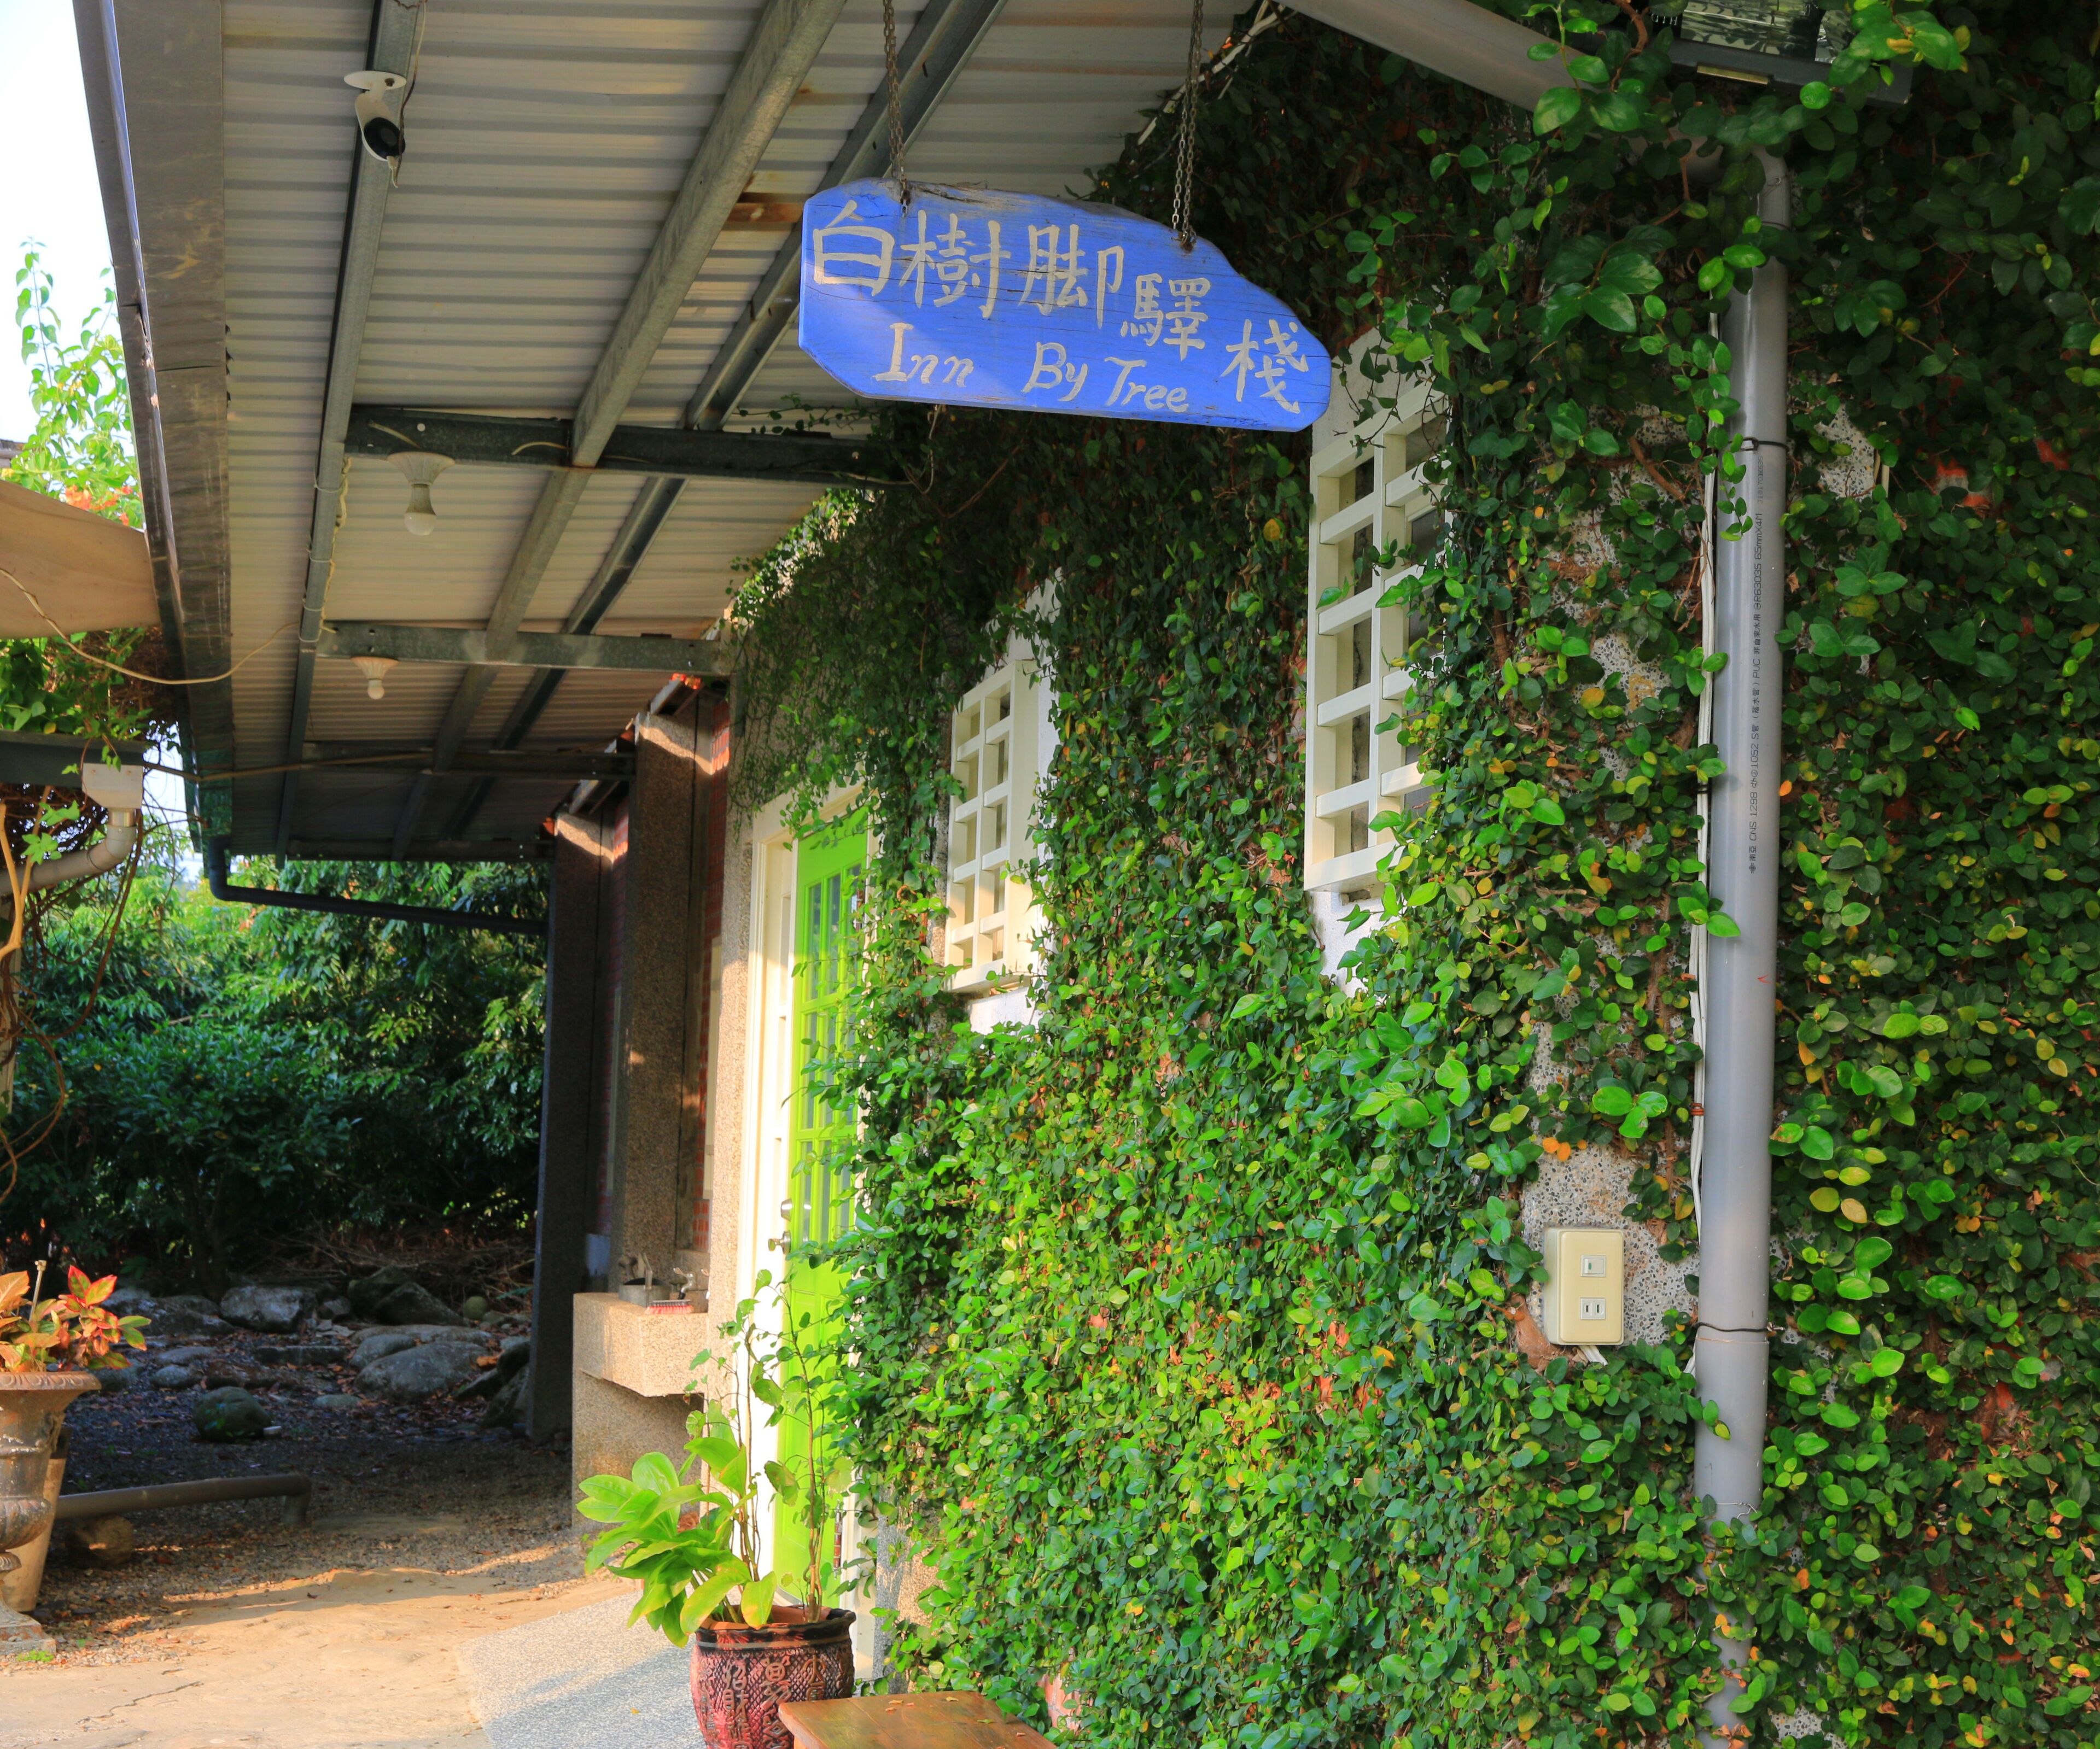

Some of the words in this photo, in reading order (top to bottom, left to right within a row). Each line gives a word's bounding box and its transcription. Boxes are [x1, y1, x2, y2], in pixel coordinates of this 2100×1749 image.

[874, 322, 974, 388] Inn
[1022, 342, 1088, 402] By
[1104, 357, 1189, 413] Tree
[1749, 846, 1757, 861] 南亞
